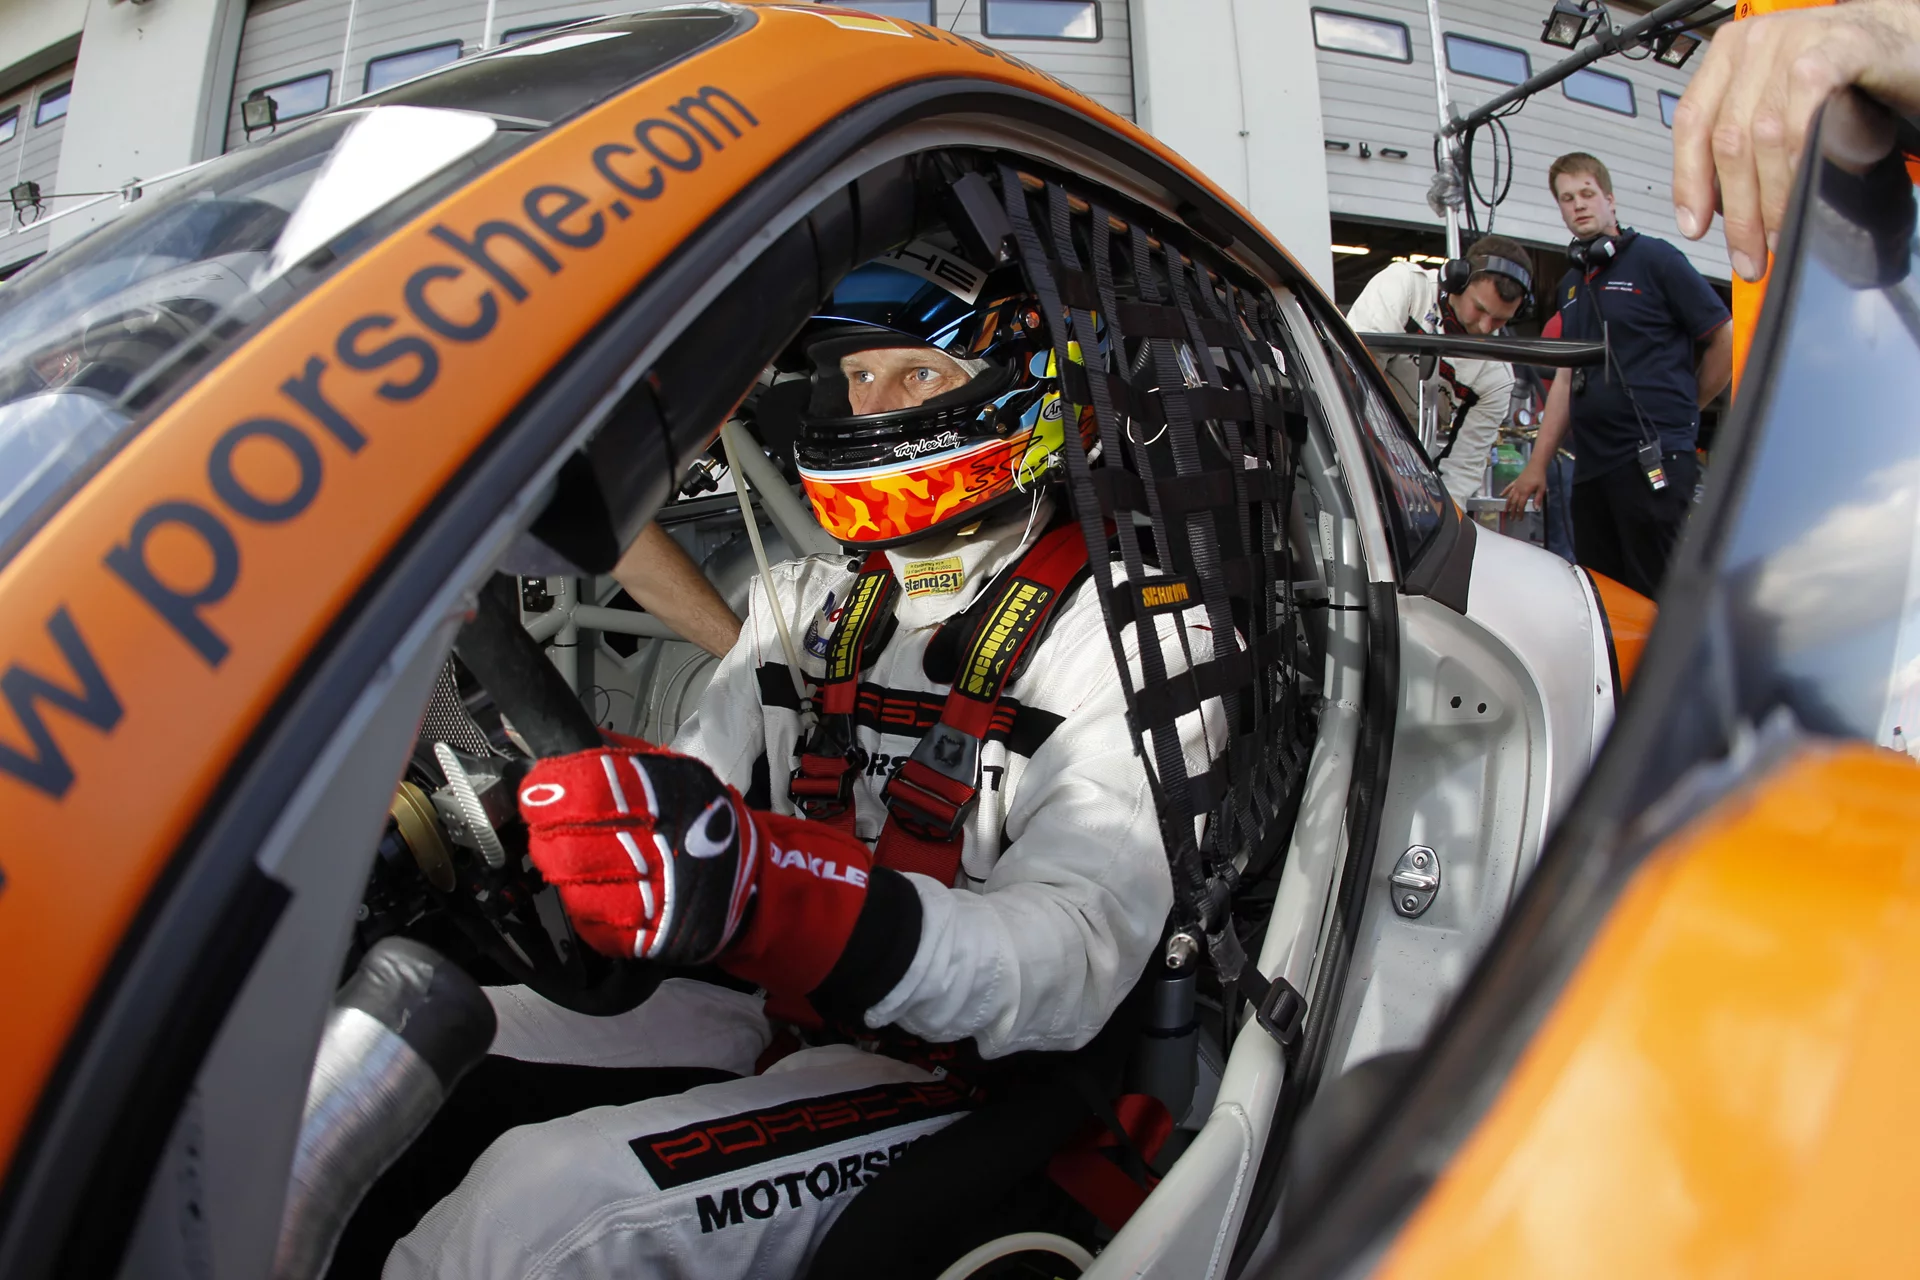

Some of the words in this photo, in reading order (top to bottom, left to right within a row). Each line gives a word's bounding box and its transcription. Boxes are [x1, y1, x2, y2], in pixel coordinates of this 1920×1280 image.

[103, 84, 760, 670] porsche.com
[893, 442, 918, 459] Troy
[919, 438, 940, 451] Lee
[835, 575, 879, 678] SCHROTH
[967, 584, 1039, 694] SCHROTH
[984, 591, 1048, 697] RACING
[650, 1081, 962, 1171] PORSCHE
